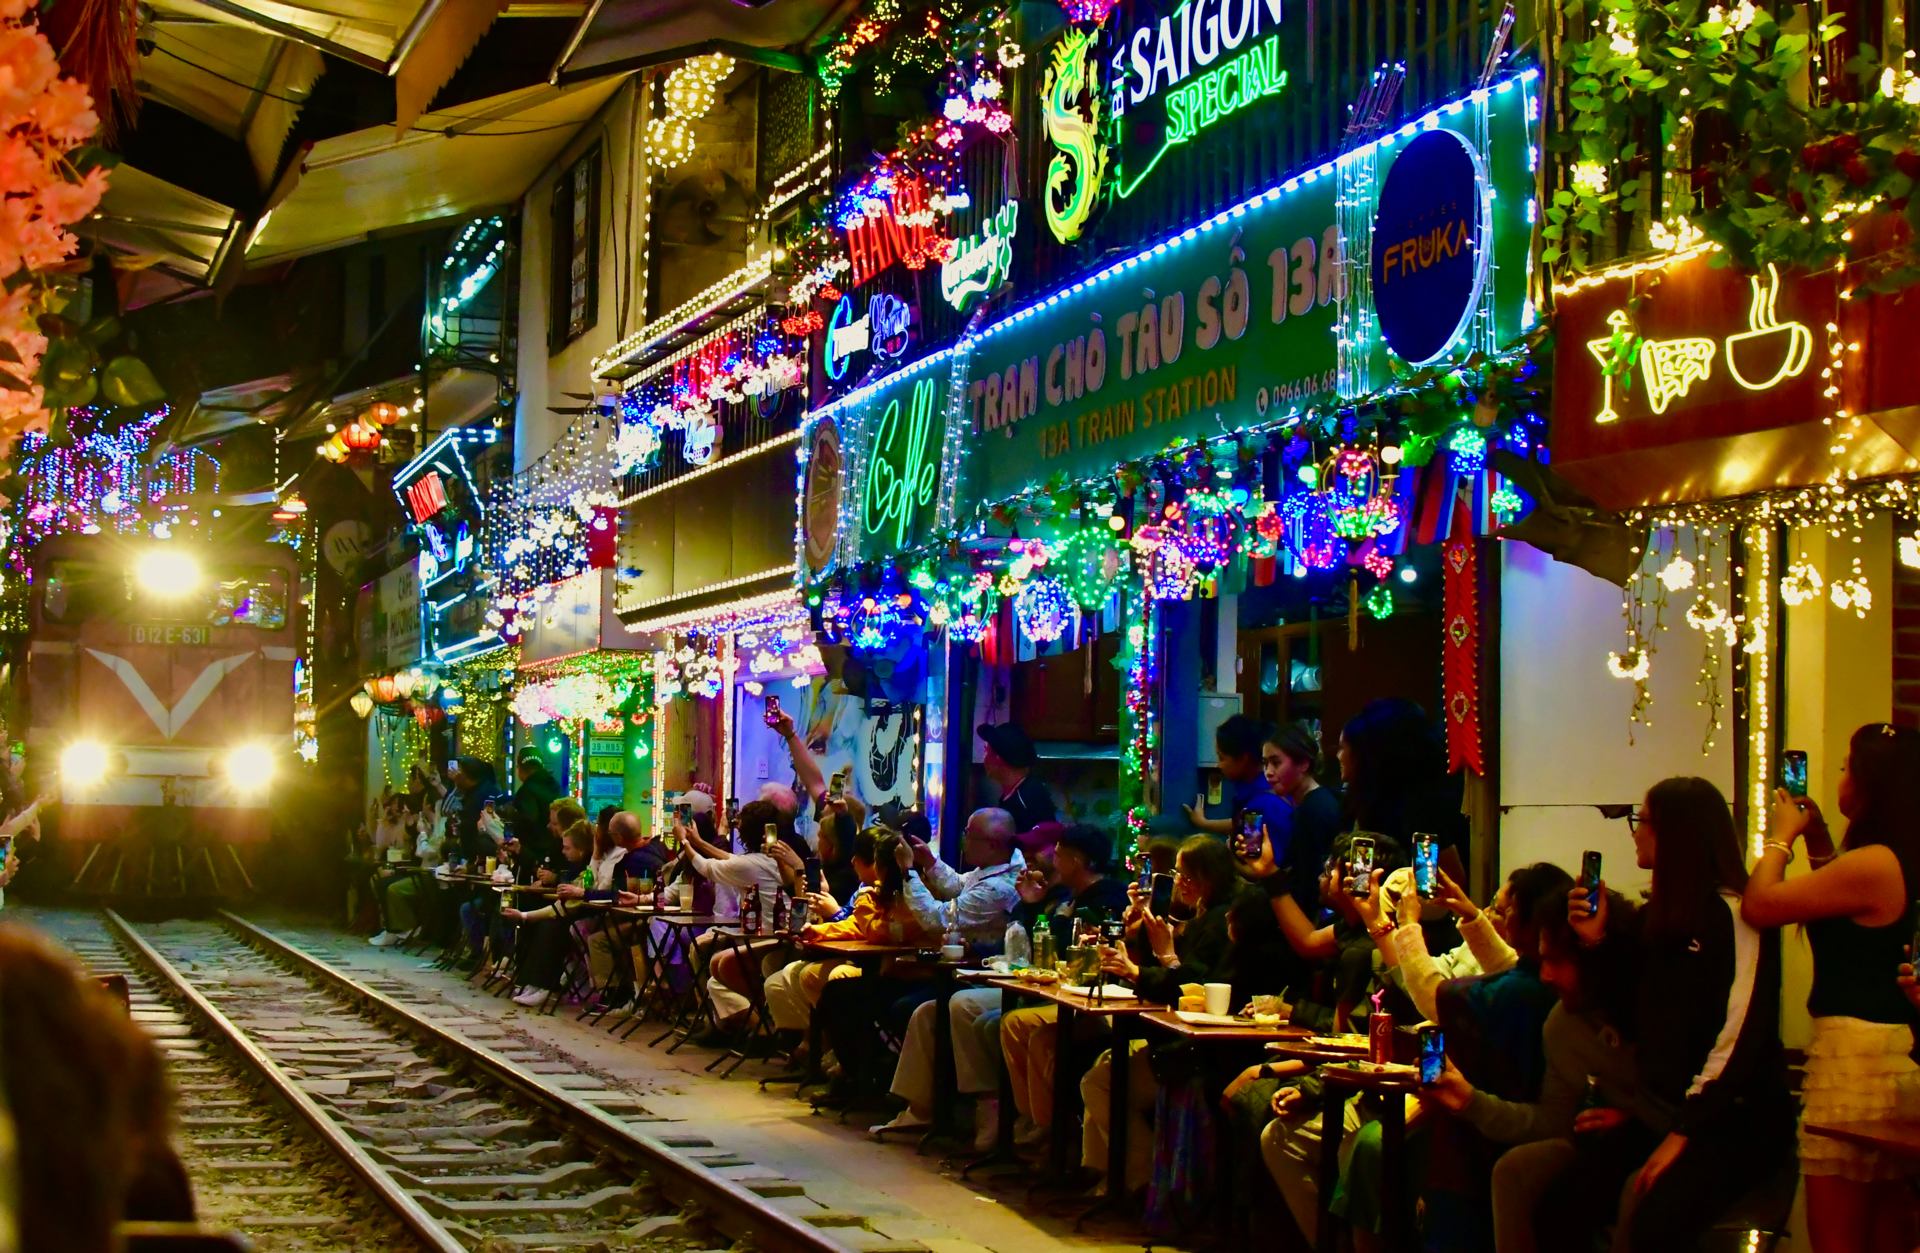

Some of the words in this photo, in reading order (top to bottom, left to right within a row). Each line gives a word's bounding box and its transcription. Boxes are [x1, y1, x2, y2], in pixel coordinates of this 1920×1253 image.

[1112, 44, 1125, 119] BIA
[1131, 0, 1282, 104] SAIGON
[1166, 35, 1287, 143] SPECIAL
[1383, 219, 1471, 284] FRUKA
[968, 355, 1039, 438] TRẠM
[1117, 288, 1184, 380] TÀU
[1196, 226, 1249, 350] SỐ
[1267, 225, 1348, 325] 13A
[1040, 421, 1071, 460] 13A
[1077, 400, 1134, 448] TRAIN
[1142, 365, 1237, 428] STATION
